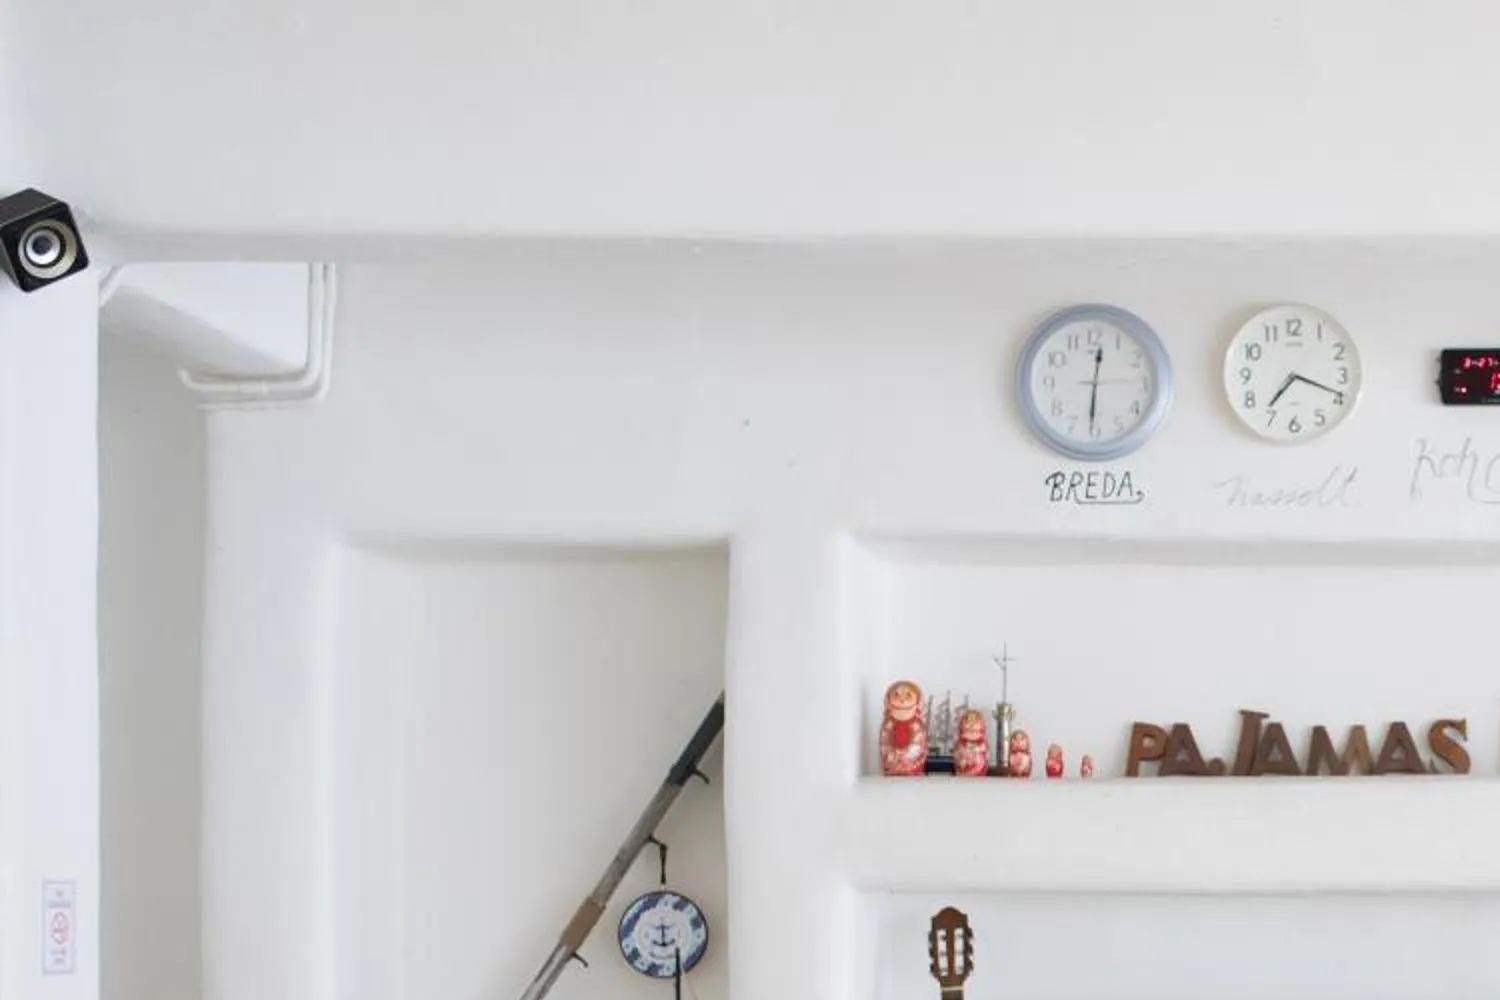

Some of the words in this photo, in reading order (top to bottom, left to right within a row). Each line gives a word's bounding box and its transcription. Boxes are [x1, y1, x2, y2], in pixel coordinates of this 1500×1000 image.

[1264, 324, 1278, 342] 11
[1286, 318, 1303, 337] 12
[1067, 334, 1079, 352] 11
[1244, 342, 1262, 361] 10
[1332, 342, 1346, 360] 2
[1239, 367, 1252, 385] 9
[1337, 366, 1349, 385] 3
[1244, 390, 1256, 409] 8
[1265, 409, 1278, 428] 7
[1288, 415, 1302, 433] 6
[1314, 409, 1326, 427] 5
